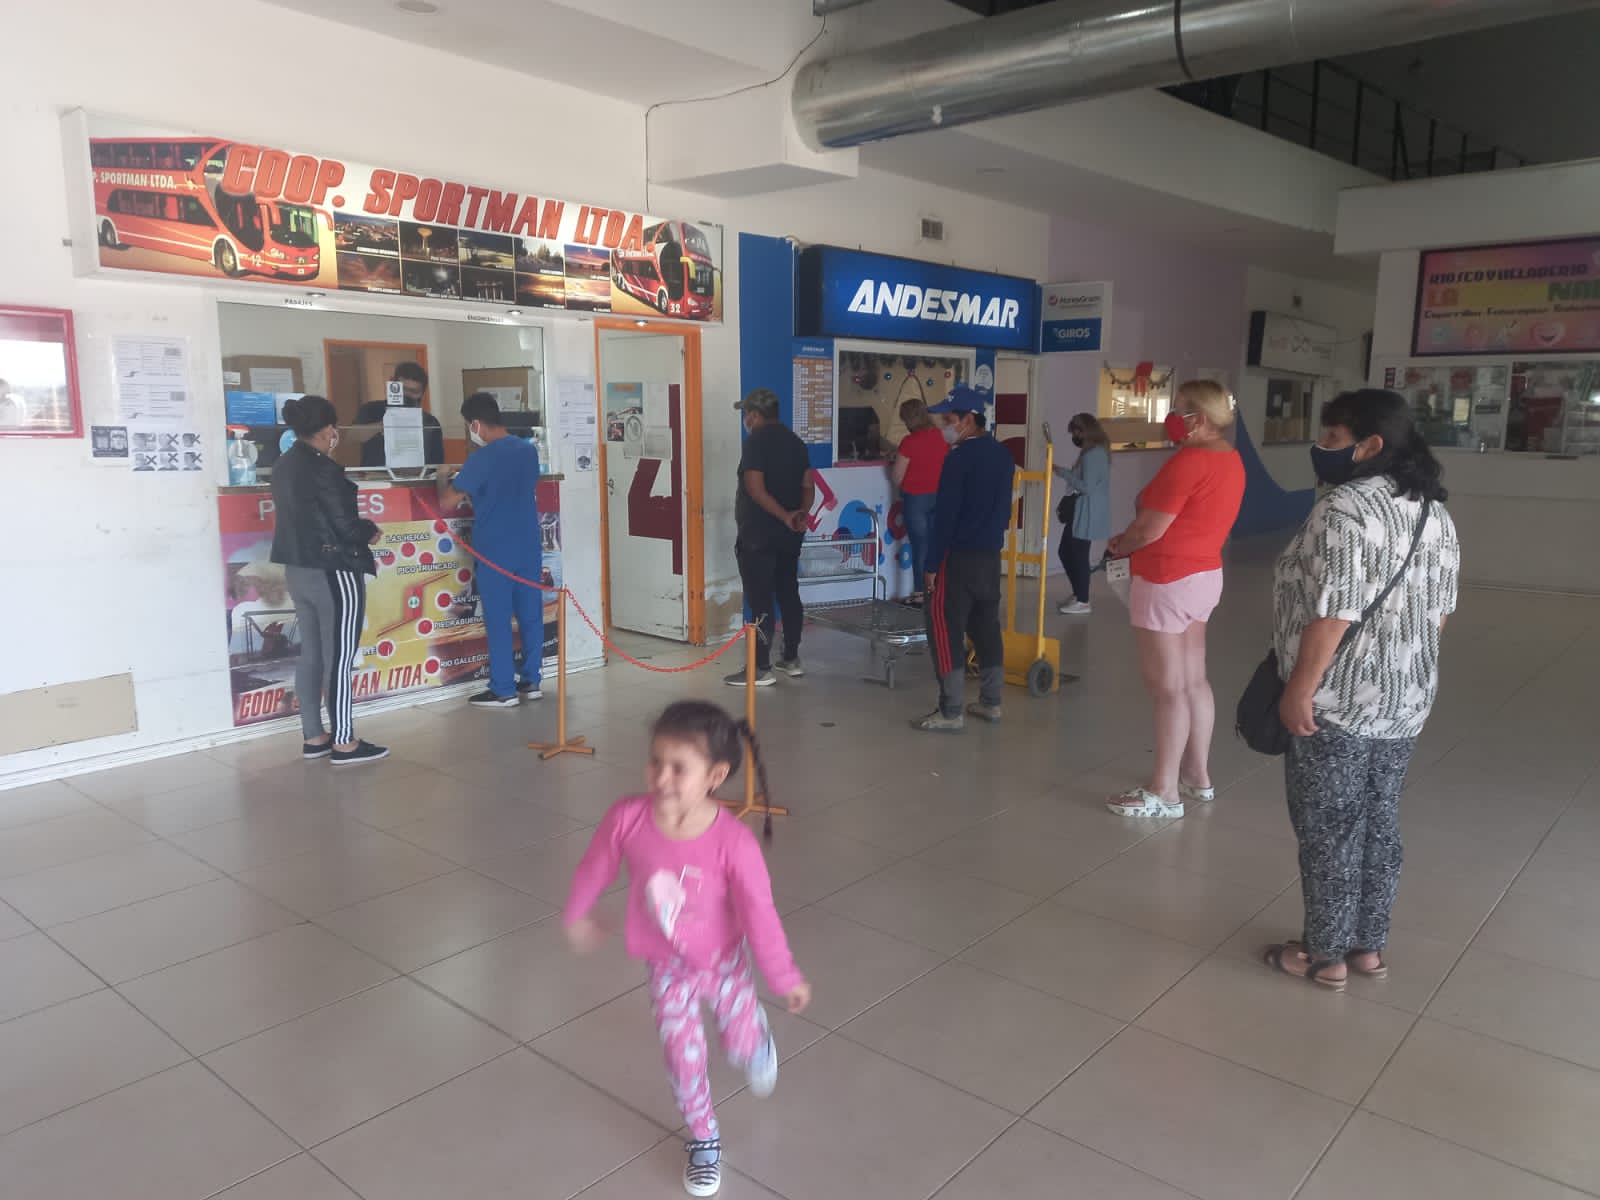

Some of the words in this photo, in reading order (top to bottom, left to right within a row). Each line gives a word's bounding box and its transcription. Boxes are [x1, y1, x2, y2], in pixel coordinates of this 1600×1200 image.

[101, 172, 148, 188] SPORTMAN
[150, 174, 177, 190] LTDA.
[221, 144, 346, 208] COOP.
[363, 168, 565, 240] SPORTMAN
[670, 303, 682, 314] 32
[848, 279, 1020, 329] ANDESMAR
[1058, 328, 1091, 340] GIROS
[397, 566, 416, 575] PICO
[417, 562, 458, 573] TRUNCADO
[387, 664, 429, 691] LTDA.
